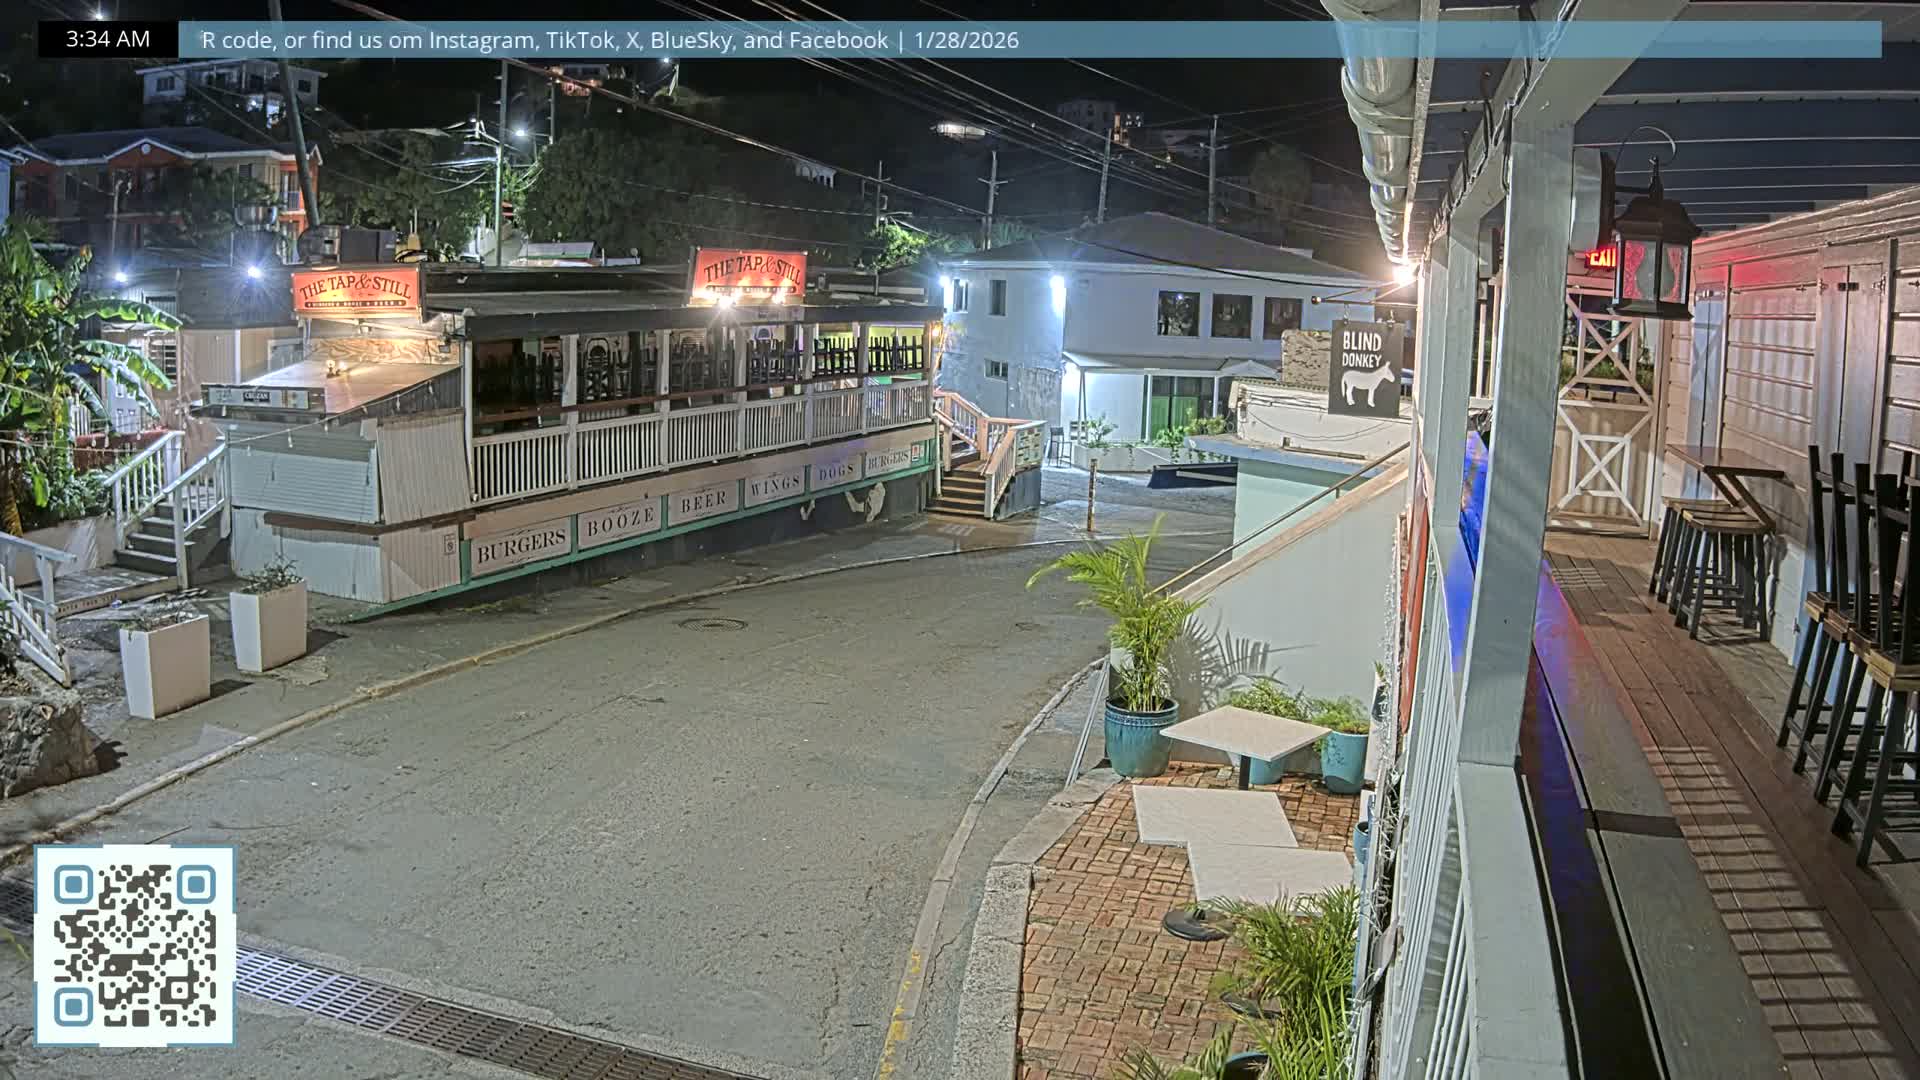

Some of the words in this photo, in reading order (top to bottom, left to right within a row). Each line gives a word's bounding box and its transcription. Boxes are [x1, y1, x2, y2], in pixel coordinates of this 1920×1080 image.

[704, 258, 734, 282] THE
[736, 256, 762, 272] TAP
[775, 259, 801, 285] STILL
[299, 279, 327, 300] THE
[328, 275, 355, 290] TAP
[372, 276, 412, 300] STILL
[1343, 331, 1382, 352] BLIND
[1342, 352, 1382, 369] DONKEY
[868, 451, 909, 470] BURGERS
[819, 464, 854, 481] DOGS
[751, 475, 799, 496] WINGS
[682, 490, 726, 513] BEER
[588, 507, 654, 537] BOOZE
[478, 528, 566, 564] BURGERS
